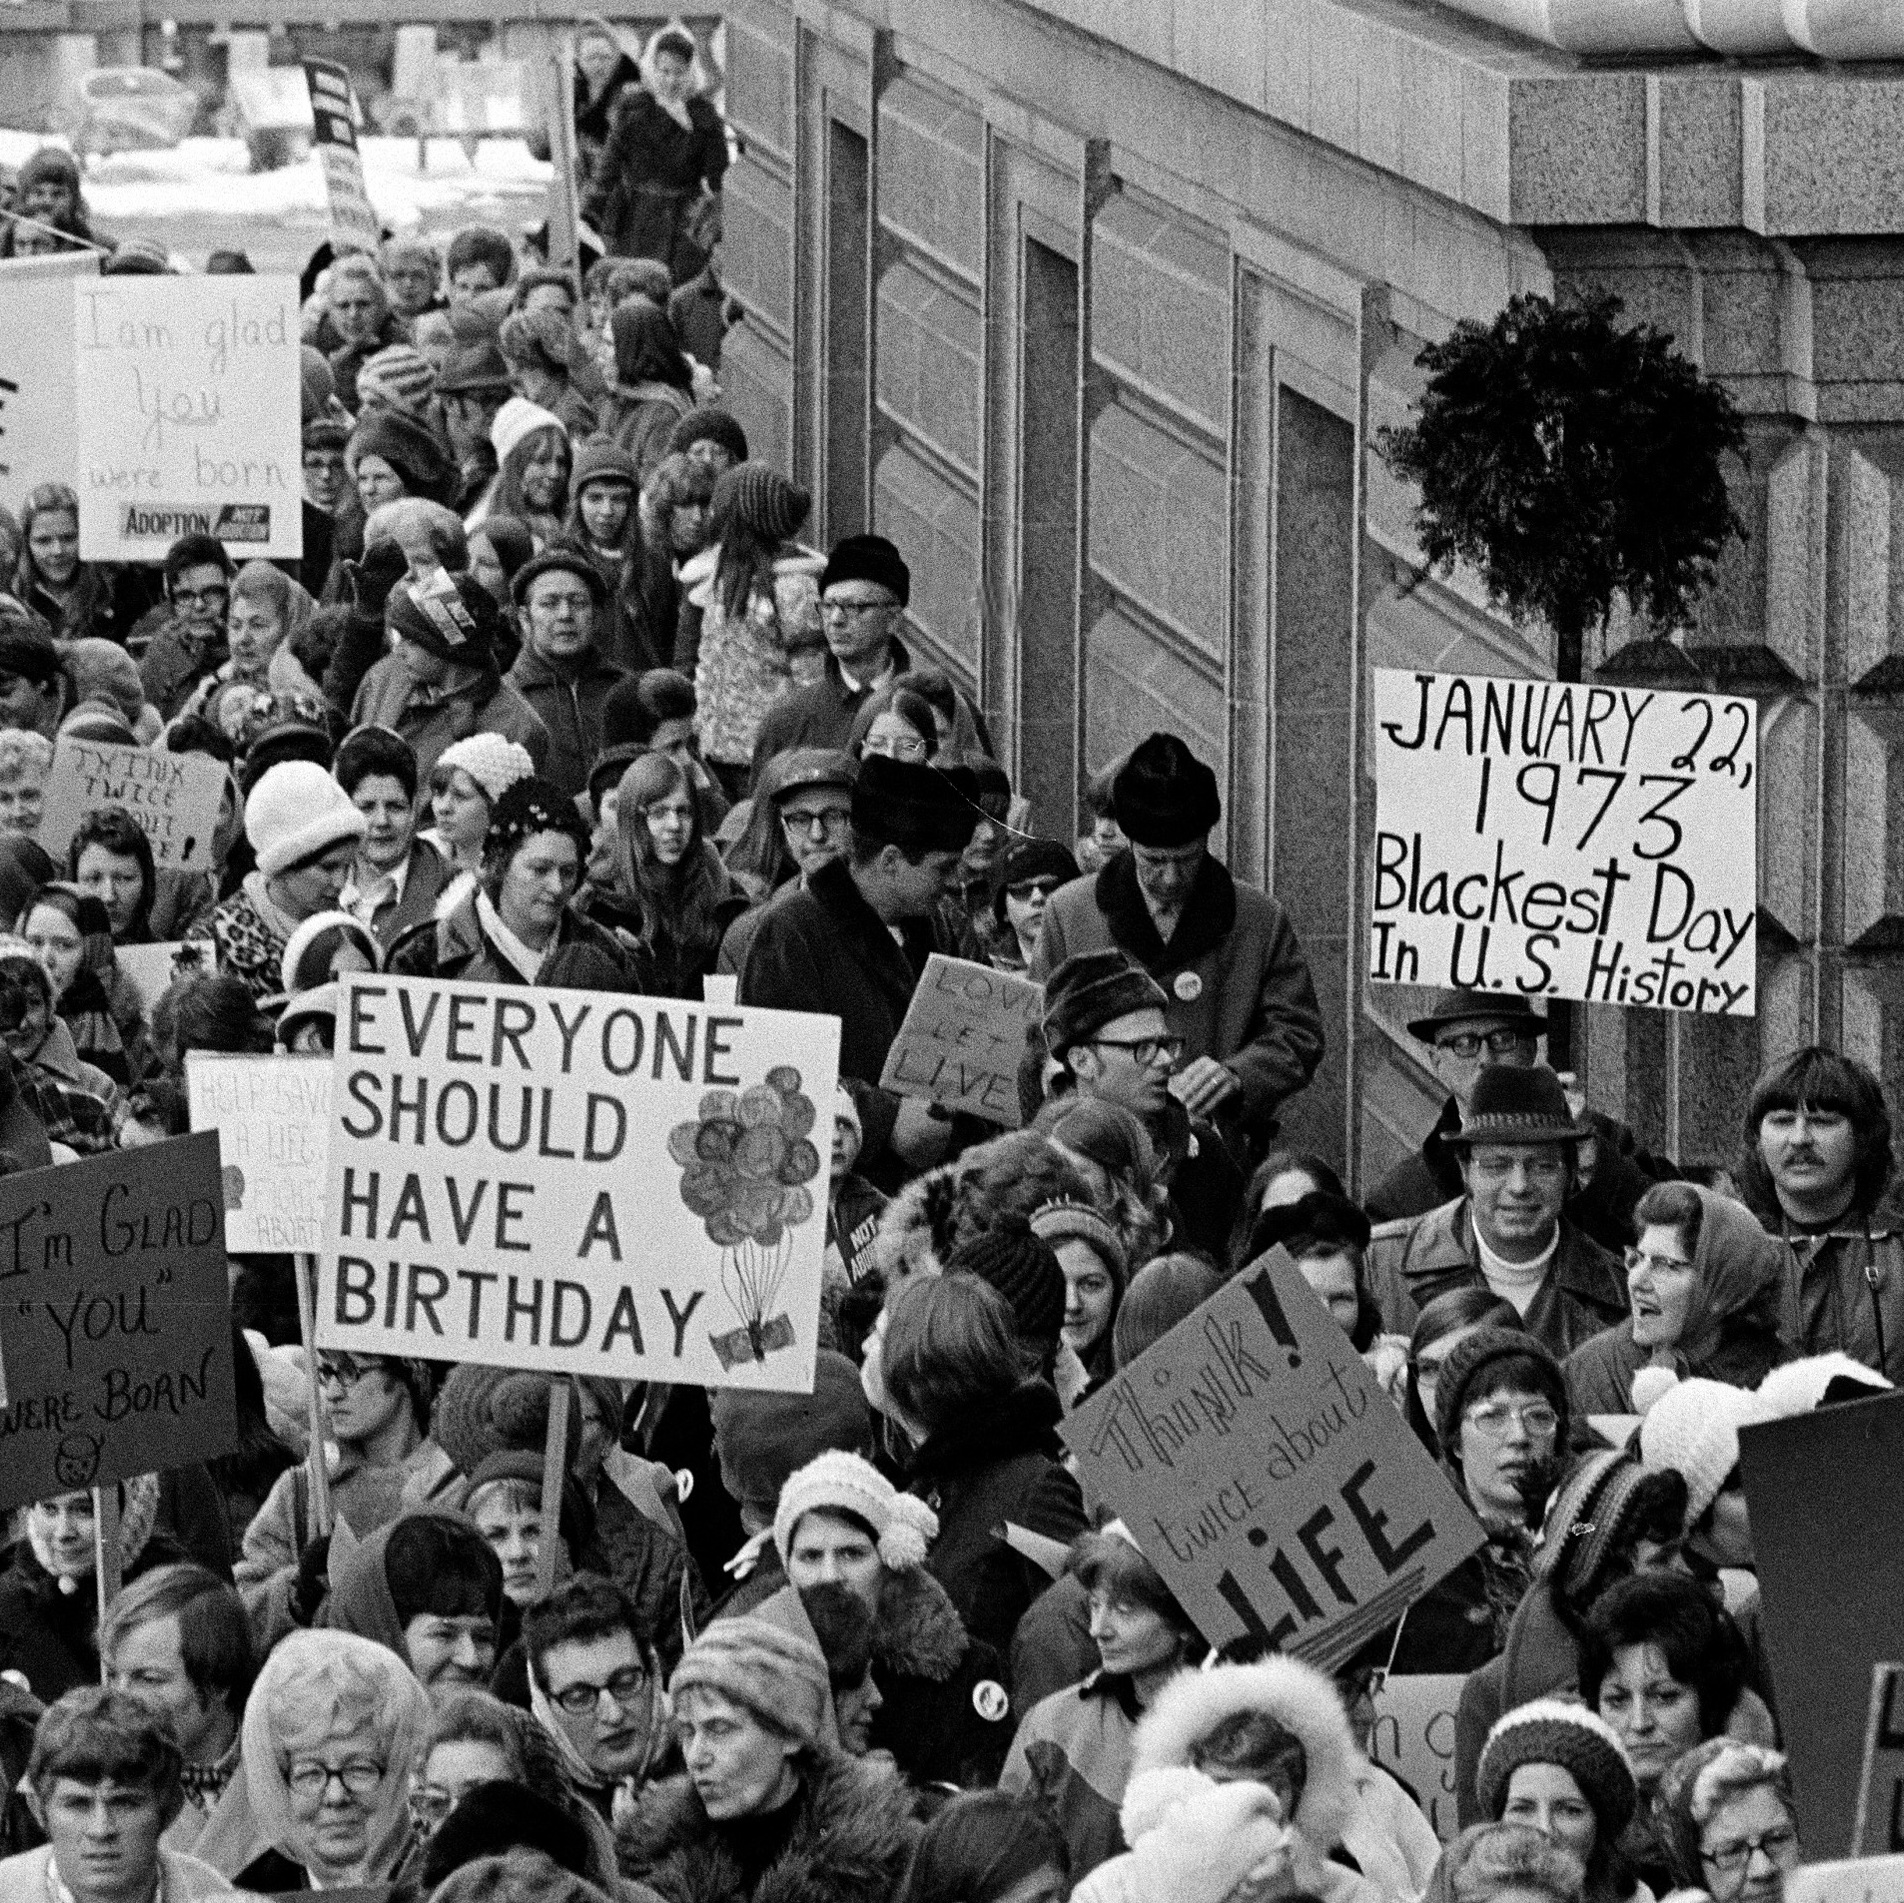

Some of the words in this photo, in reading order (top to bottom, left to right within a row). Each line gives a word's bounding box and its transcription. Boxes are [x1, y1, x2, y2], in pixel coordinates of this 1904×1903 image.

[118, 319, 174, 350] am
[204, 294, 287, 376] glad
[194, 443, 288, 491] born
[125, 506, 211, 536] ADOPTION
[1380, 673, 1655, 767] JANUARY
[1670, 697, 1753, 790] 22,
[1475, 756, 1697, 860] 1973
[1373, 831, 1632, 936] Blackest
[1645, 861, 1755, 970] Day
[1370, 921, 1420, 982] In
[1584, 938, 1750, 1013] History
[348, 984, 745, 1087] EVERYONE
[894, 1048, 1014, 1111] LIVE
[340, 1069, 628, 1163] SHOULD
[101, 1182, 217, 1257] GLAD
[339, 1167, 536, 1252] HAVE
[576, 1191, 623, 1262] A
[334, 1255, 705, 1358] BIRTHDAY
[93, 1345, 215, 1422] BORN
[1266, 1360, 1368, 1482] about
